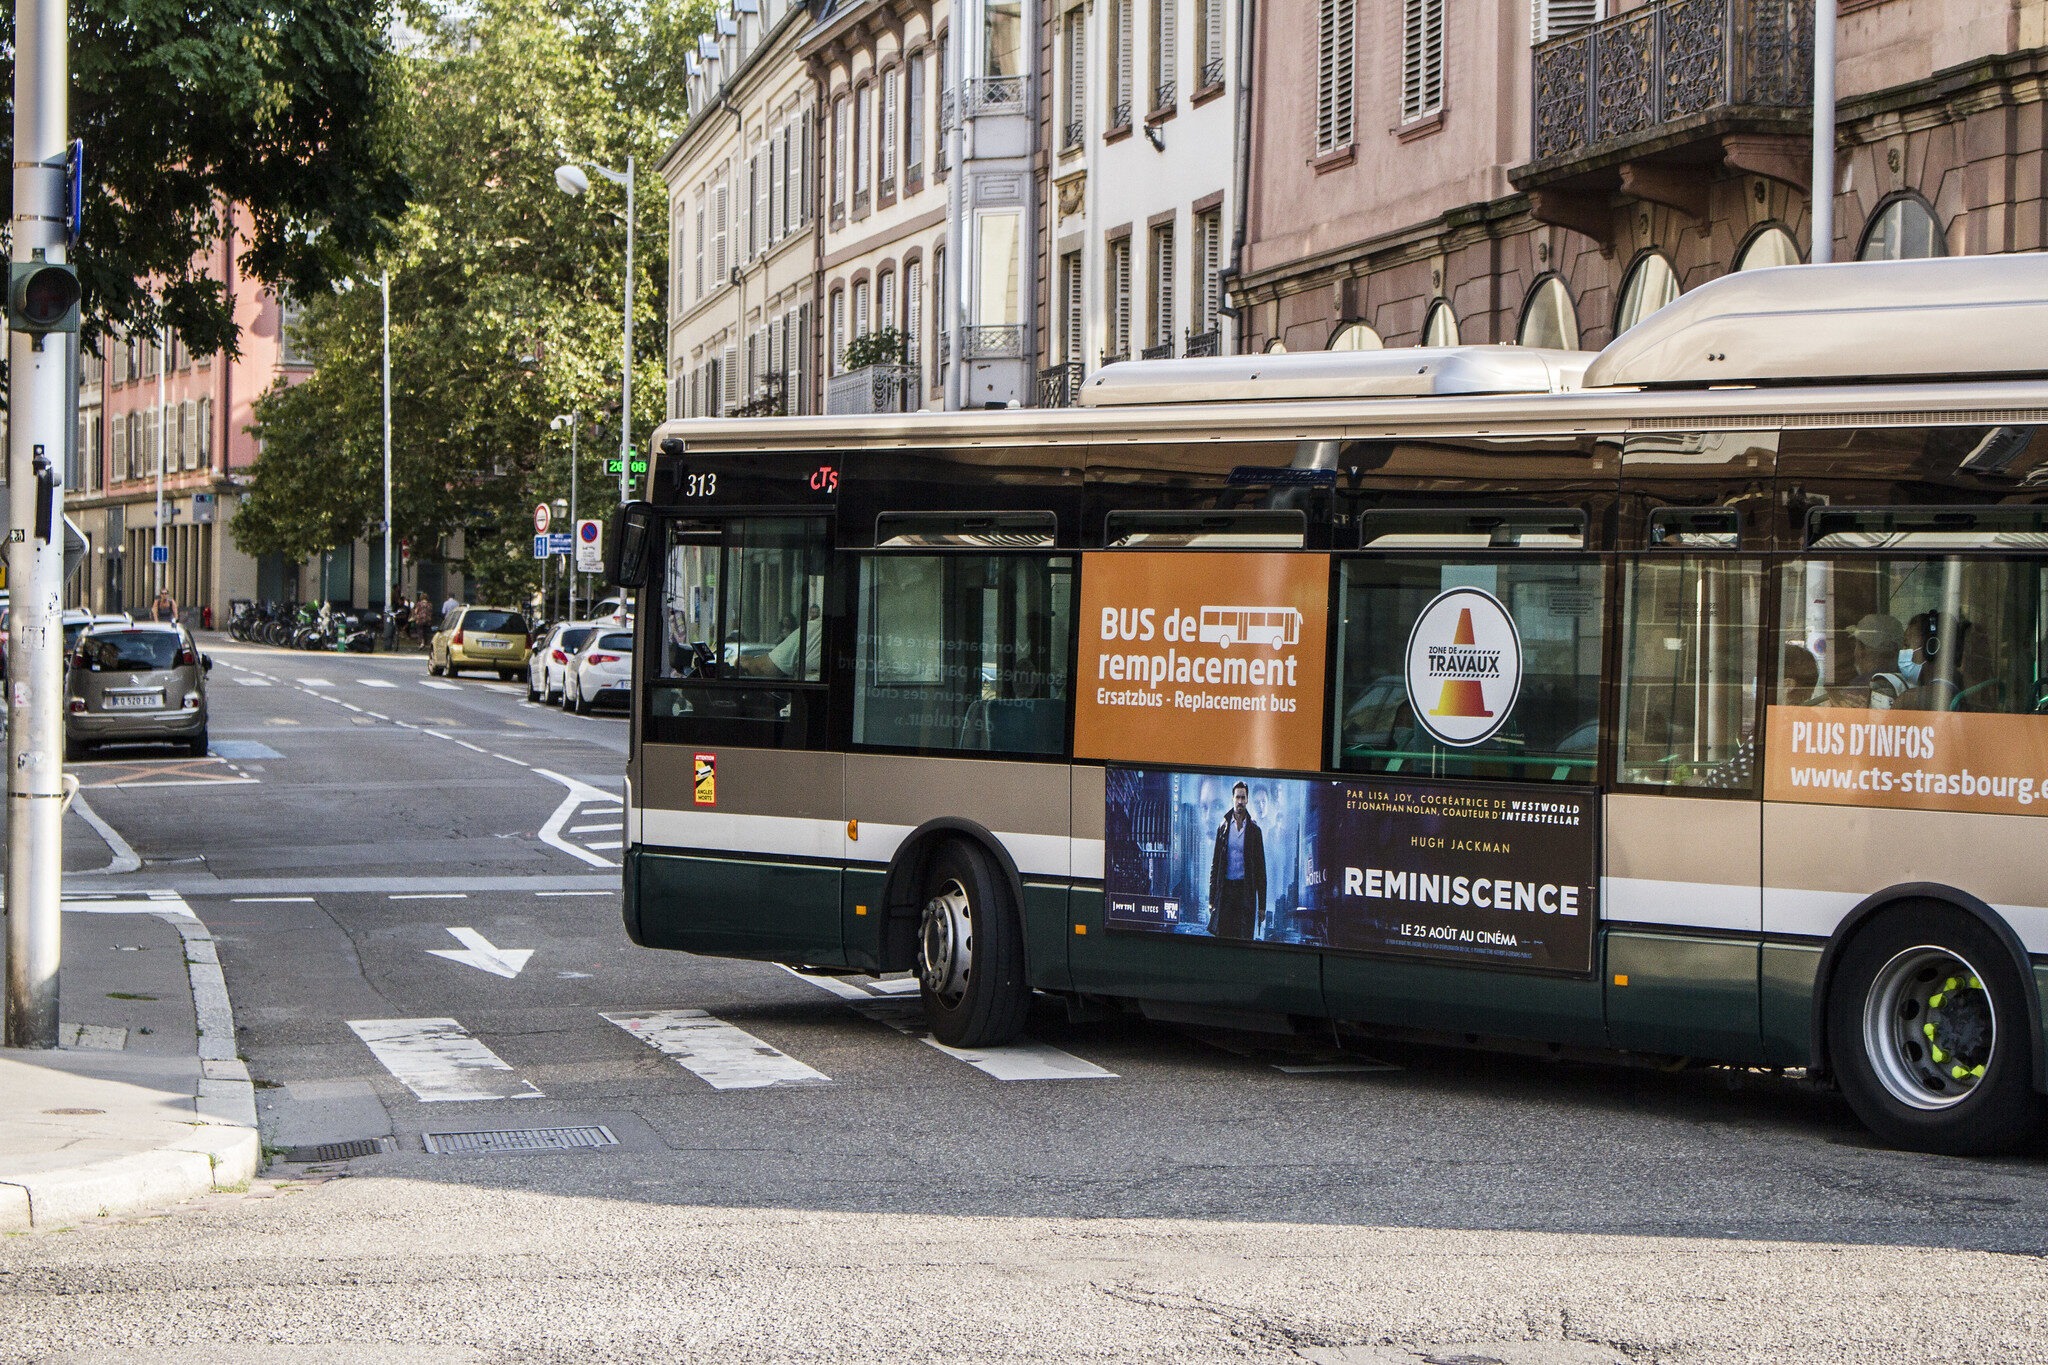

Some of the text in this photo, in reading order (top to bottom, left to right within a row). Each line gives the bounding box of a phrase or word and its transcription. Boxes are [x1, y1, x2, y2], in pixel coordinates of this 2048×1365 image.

[686, 473, 717, 497] 313
[810, 466, 839, 490] CTS
[1101, 607, 1197, 643] BUS de
[1429, 646, 1446, 654] ZONE
[1098, 648, 1298, 690] remplacement
[1428, 655, 1499, 672] TRAVAUX
[1097, 687, 1163, 707] Ersatzbus
[1174, 691, 1267, 713] Replacement
[1270, 693, 1297, 713] bus
[1791, 721, 1935, 759] PLUS D'INFOS
[1346, 789, 1580, 814] PAR LISA JOY, COCRÉATRICE DE WESTWORLD
[1347, 801, 1357, 809] ET
[1358, 801, 1404, 813] JONATHAN
[1406, 804, 1440, 816] NOLAN,
[1442, 807, 1490, 819] COAUTEUR
[1411, 836, 1511, 854] HUGH JACKMAN
[1344, 866, 1580, 916] REMINISCENCE
[1164, 902, 1179, 911] BFM
[1401, 923, 1412, 936] LE
[1414, 924, 1427, 937] 25
[1428, 925, 1457, 940] AOÛT
[1459, 930, 1474, 942] AU
[1477, 931, 1517, 946] CINÉMA
